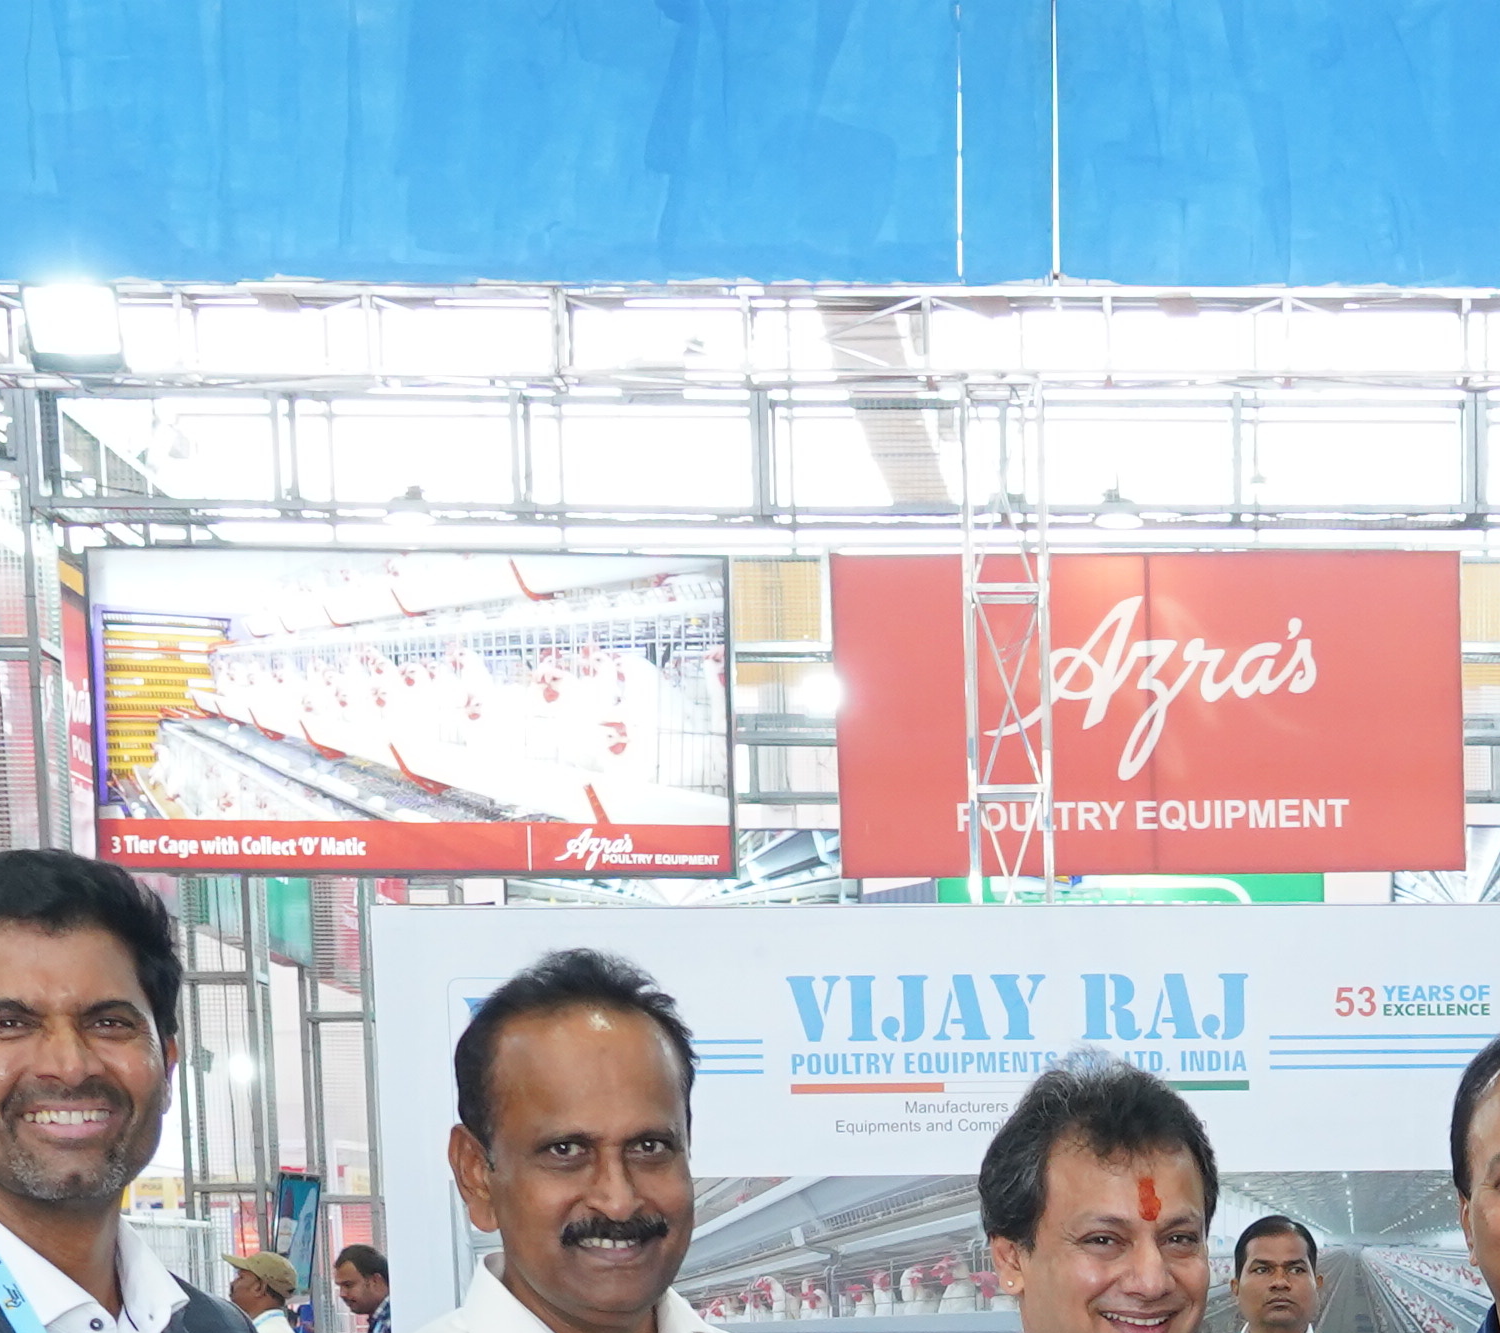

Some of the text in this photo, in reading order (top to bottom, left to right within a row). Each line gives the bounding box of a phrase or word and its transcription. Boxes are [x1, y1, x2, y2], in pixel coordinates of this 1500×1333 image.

[982, 594, 1319, 781] Azra's
[1136, 799, 1350, 832] EQUIPMENT
[111, 836, 121, 853] 3
[123, 835, 156, 854] Tier
[158, 836, 199, 858] Cage
[201, 836, 239, 855] with
[241, 837, 296, 855] Collect
[320, 837, 367, 856] Matic
[554, 827, 634, 871] Azra's
[602, 853, 720, 865] POULTRY EQUIPMENT
[1334, 985, 1377, 1018] 53
[1382, 985, 1492, 1002] YEARS OF
[785, 972, 1249, 1043] VIJAY RAJ
[1382, 1003, 1492, 1017] EXCELLENCE
[790, 1051, 895, 1076] POULTRY
[903, 1050, 1058, 1075] EQUIPMENTS
[1181, 1050, 1248, 1073] INDIA
[904, 1099, 1009, 1115] Manufacturers
[835, 1116, 1006, 1135] Equipments and Compl
